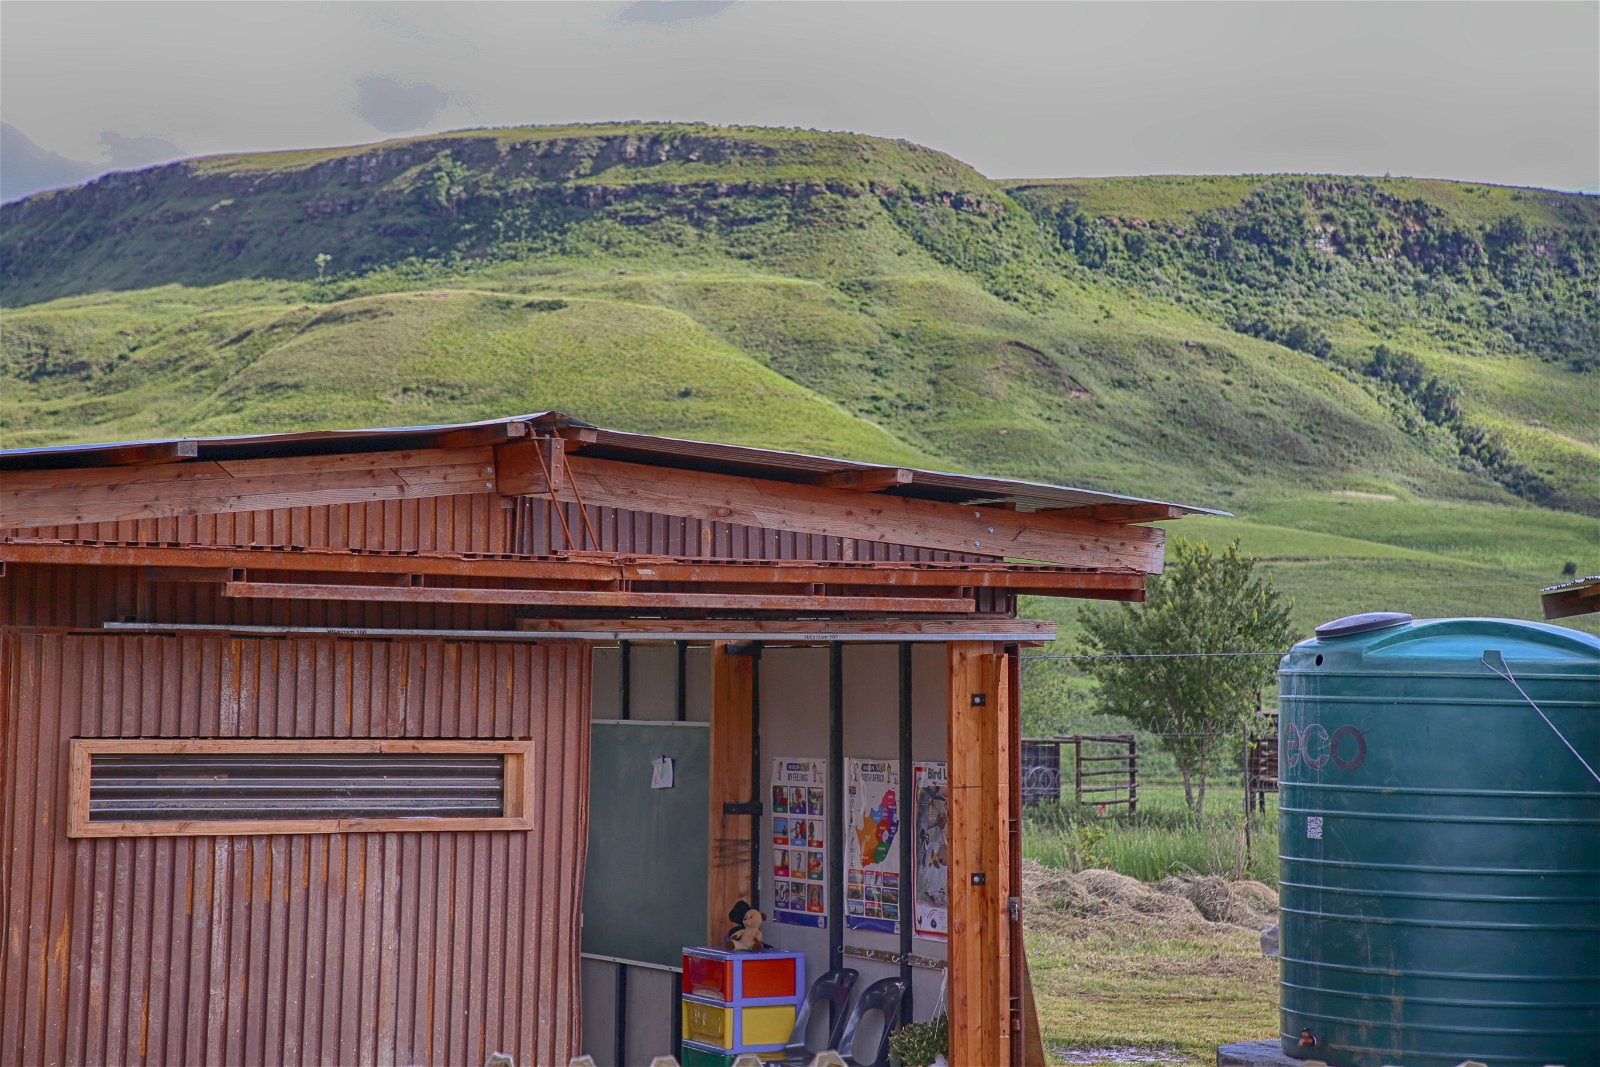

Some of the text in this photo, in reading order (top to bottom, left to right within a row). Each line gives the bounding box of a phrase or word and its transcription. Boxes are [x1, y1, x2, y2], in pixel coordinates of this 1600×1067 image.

[1283, 723, 1367, 771] eco
[793, 773, 808, 782] FEELINGS
[872, 773, 884, 782] AFRICA
[928, 768, 948, 780] Bird L
